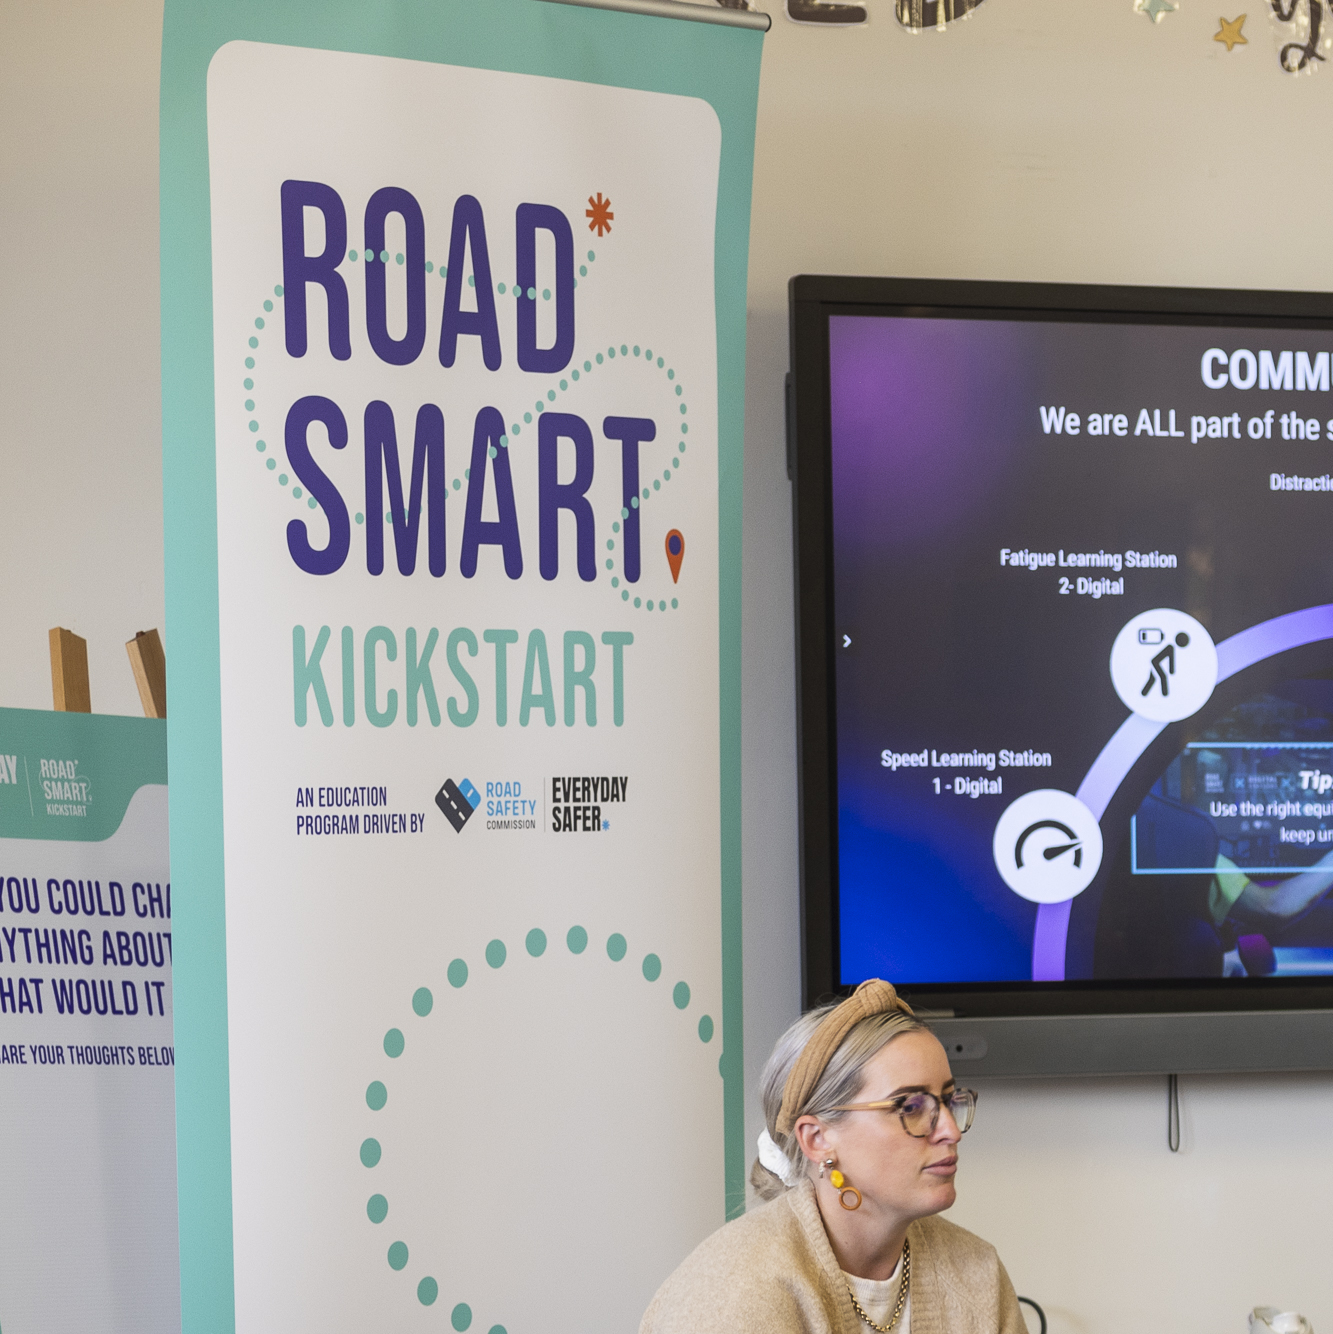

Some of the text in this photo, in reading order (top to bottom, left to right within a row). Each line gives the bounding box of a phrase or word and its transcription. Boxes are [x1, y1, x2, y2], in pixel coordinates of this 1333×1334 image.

[280, 179, 576, 374] ROAD
[1039, 405, 1081, 436] We
[1087, 413, 1129, 437] are
[1133, 408, 1185, 438] ALL
[1191, 411, 1241, 444] part
[1247, 409, 1275, 440] of
[1280, 410, 1320, 441] the
[284, 395, 657, 584] SMART
[1000, 548, 1178, 572] Fatigue Learning Station
[1076, 577, 1124, 599] Digital
[292, 624, 635, 729] KICKSTART
[40, 758, 76, 780] ROAD
[881, 749, 1052, 771] Speed Learning Station
[43, 781, 87, 802] SMART
[296, 786, 387, 808] AN EDUCATION
[486, 781, 521, 798] ROAD
[552, 776, 629, 804] EVERYDAY
[932, 776, 1003, 798] 1 Digital
[46, 803, 87, 817] KICKSTART
[486, 799, 537, 817] SAFETY
[552, 805, 602, 833] SAFER
[1210, 800, 1238, 818] Use
[1240, 800, 1266, 818] the
[1267, 800, 1302, 820] right
[296, 813, 425, 835] PROGRAM DRIVEN BY
[487, 820, 536, 831] COMMISSION
[1280, 826, 1315, 846] keep
[46, 878, 126, 917] COULD
[51, 978, 138, 1016] WOULD
[144, 980, 165, 1017] IT
[30, 1044, 135, 1067] YOUR THOUGHTS
